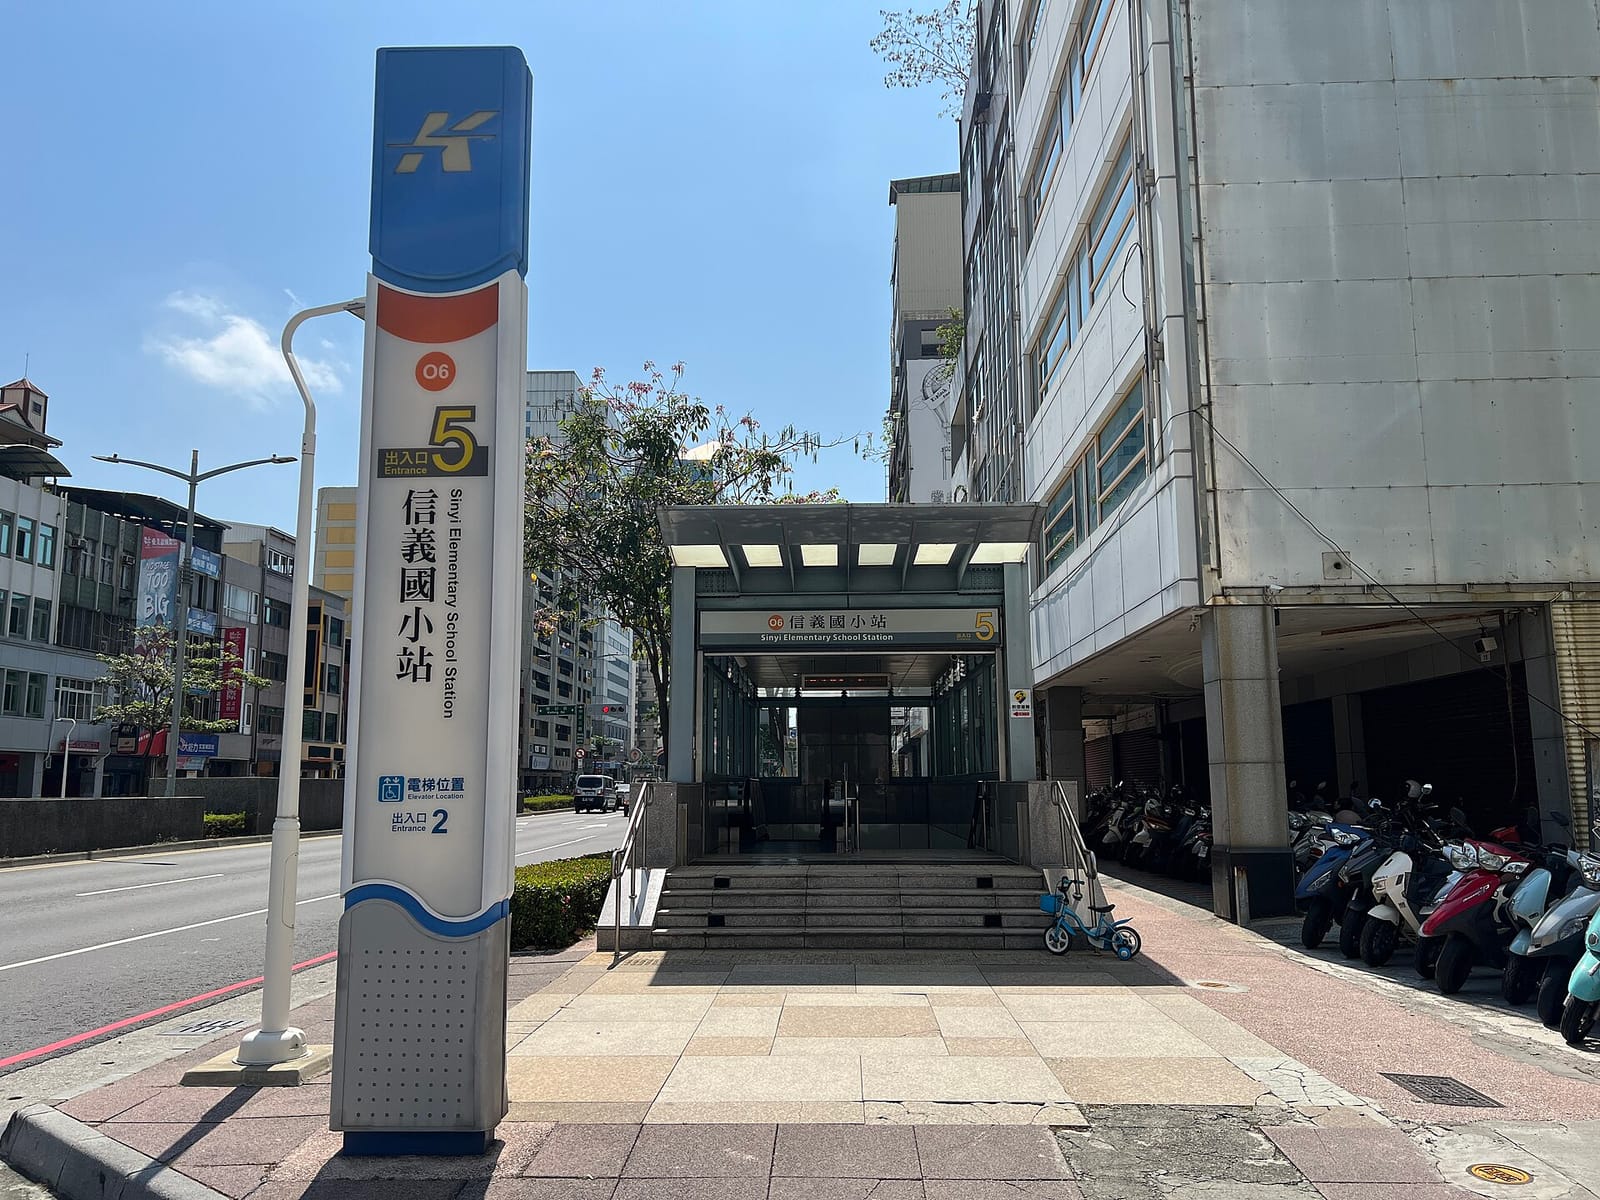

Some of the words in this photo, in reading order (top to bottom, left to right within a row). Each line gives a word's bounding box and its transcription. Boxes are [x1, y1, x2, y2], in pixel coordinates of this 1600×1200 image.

[429, 406, 477, 473] 5
[384, 451, 428, 465] 出入口
[384, 466, 427, 475] Entrance
[447, 488, 463, 523] Sinyi
[146, 571, 169, 590] TOO
[444, 528, 462, 608] Elementary
[395, 488, 438, 683] 信義國小站
[143, 593, 170, 619] BIG
[789, 614, 887, 629] 信義國小站
[975, 611, 995, 641] 5
[445, 612, 459, 662] School
[760, 633, 782, 642] Sinyi
[783, 633, 832, 642] Elementary
[832, 633, 861, 641] School
[862, 633, 894, 641] Station
[443, 667, 457, 718] Station
[407, 777, 465, 792] 電梯位置
[392, 812, 427, 824] 出入口
[431, 808, 448, 834] 2
